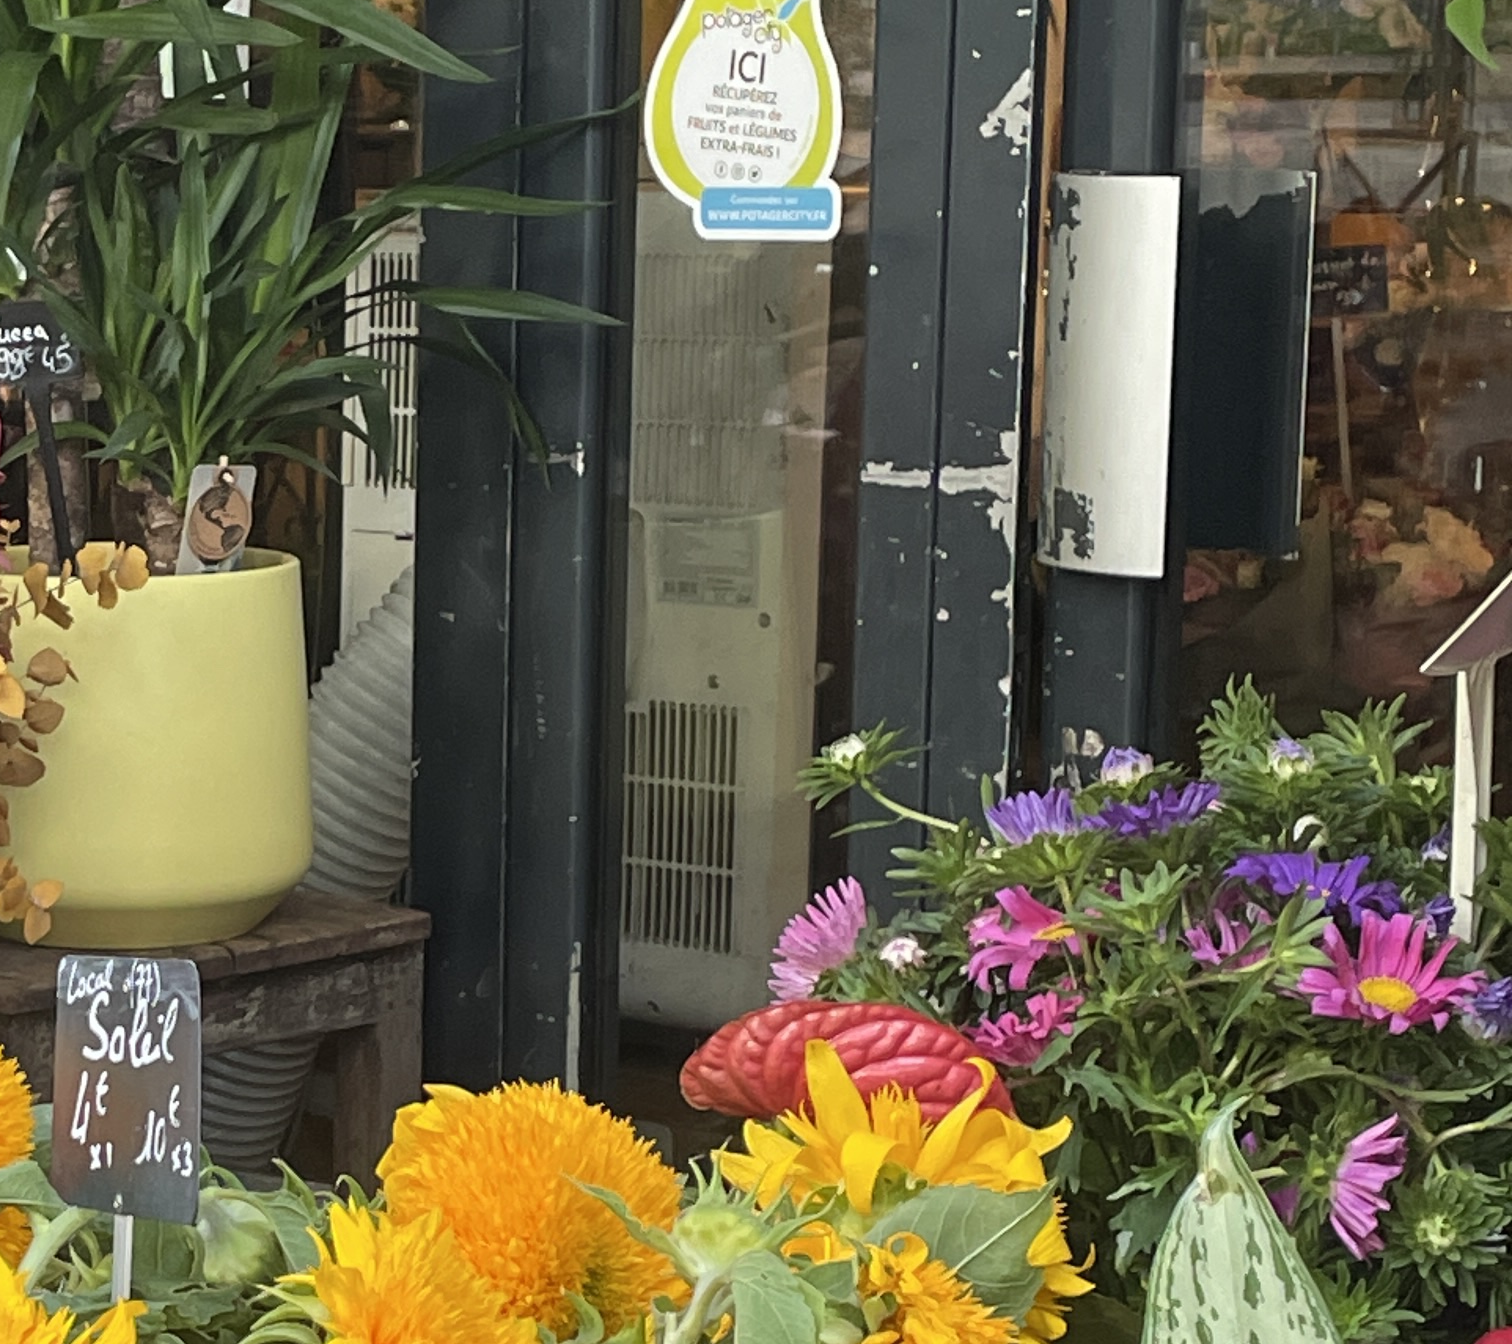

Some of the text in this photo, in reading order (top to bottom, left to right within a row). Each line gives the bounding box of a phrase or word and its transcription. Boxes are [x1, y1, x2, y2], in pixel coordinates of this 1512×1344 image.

[702, 7, 774, 38] potager
[729, 49, 766, 84] ICI
[712, 83, 778, 105] RÉCUPÉREZ
[688, 115, 797, 143] FRUITS et LÉGUMES
[768, 108, 782, 122] de
[82, 991, 179, 1068] Soleil
